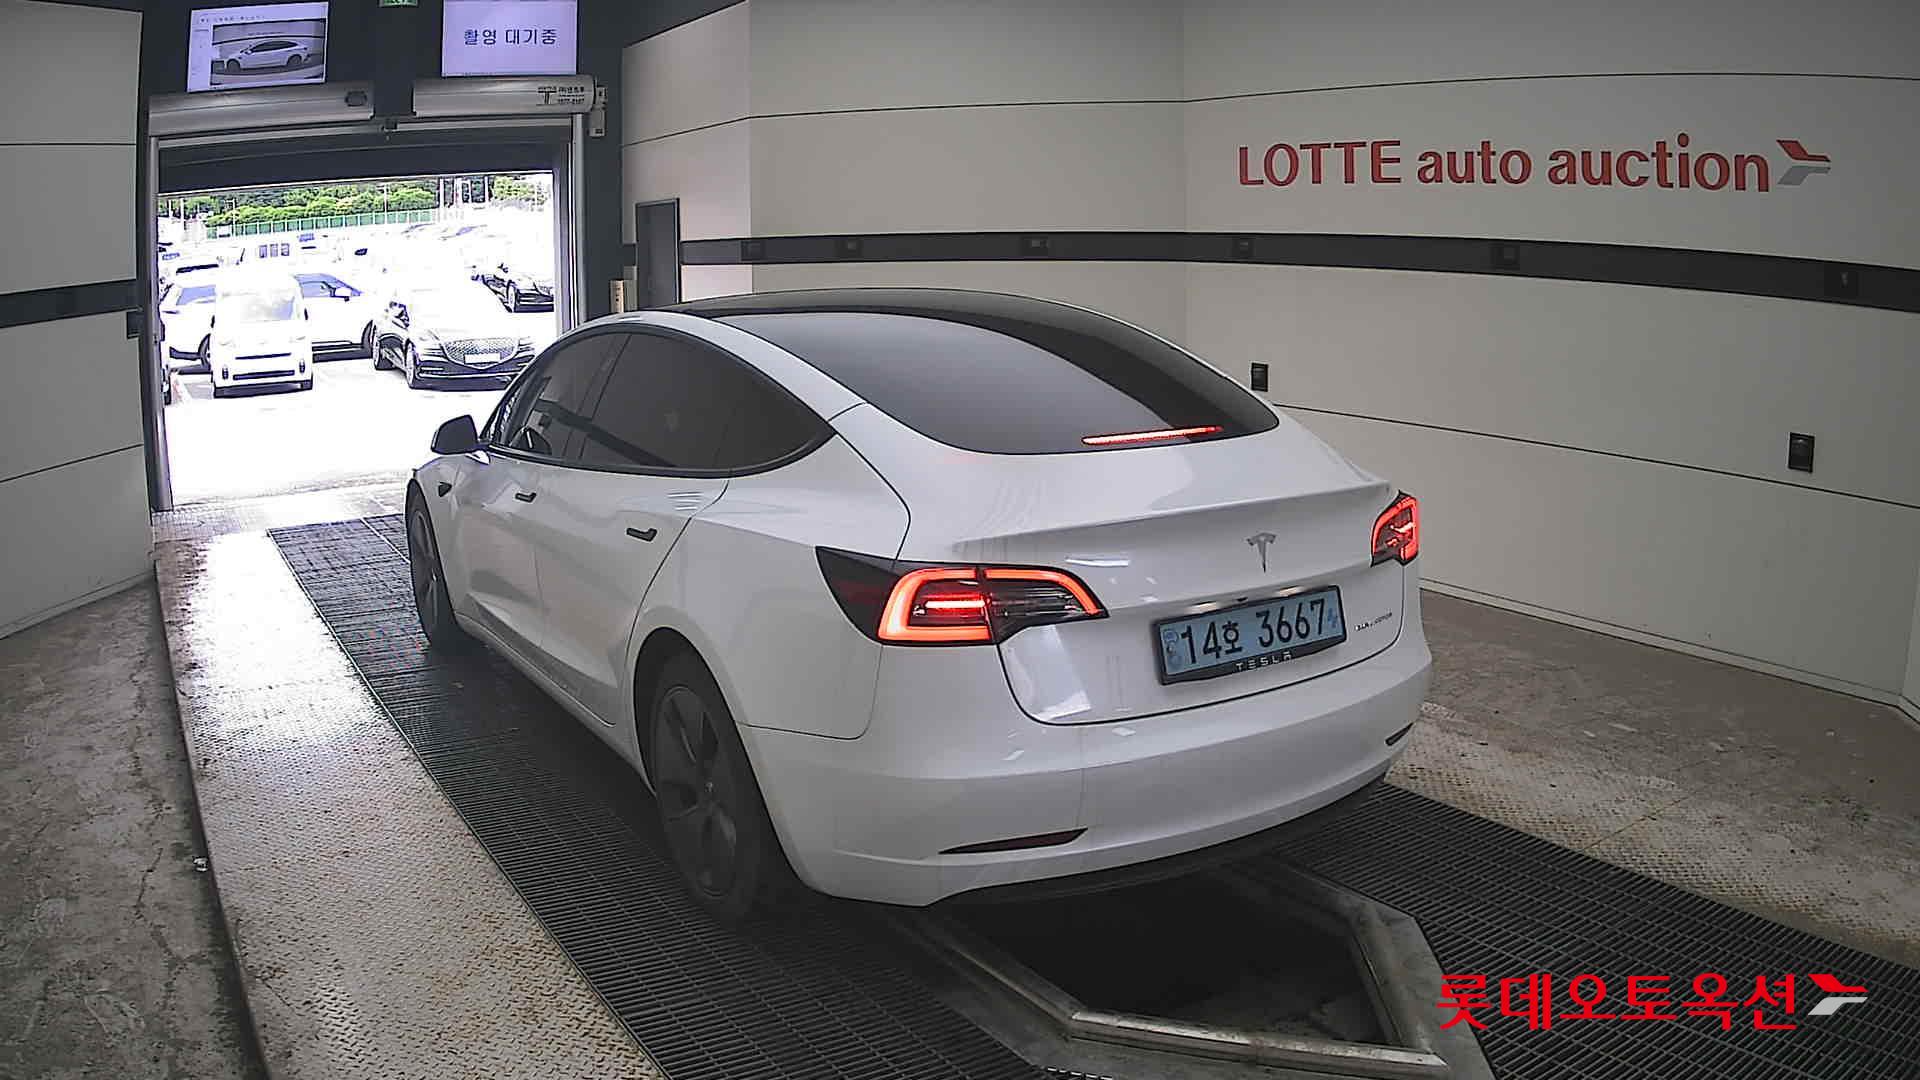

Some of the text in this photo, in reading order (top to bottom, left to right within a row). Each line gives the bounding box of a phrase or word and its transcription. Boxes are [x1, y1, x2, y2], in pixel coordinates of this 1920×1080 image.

[464, 29, 558, 45] 촬영 대기중
[1238, 132, 1770, 192] LOTTE auto auction
[1181, 620, 1243, 664] 14호
[1256, 598, 1326, 648] 3667
[1235, 651, 1293, 672] TESLA
